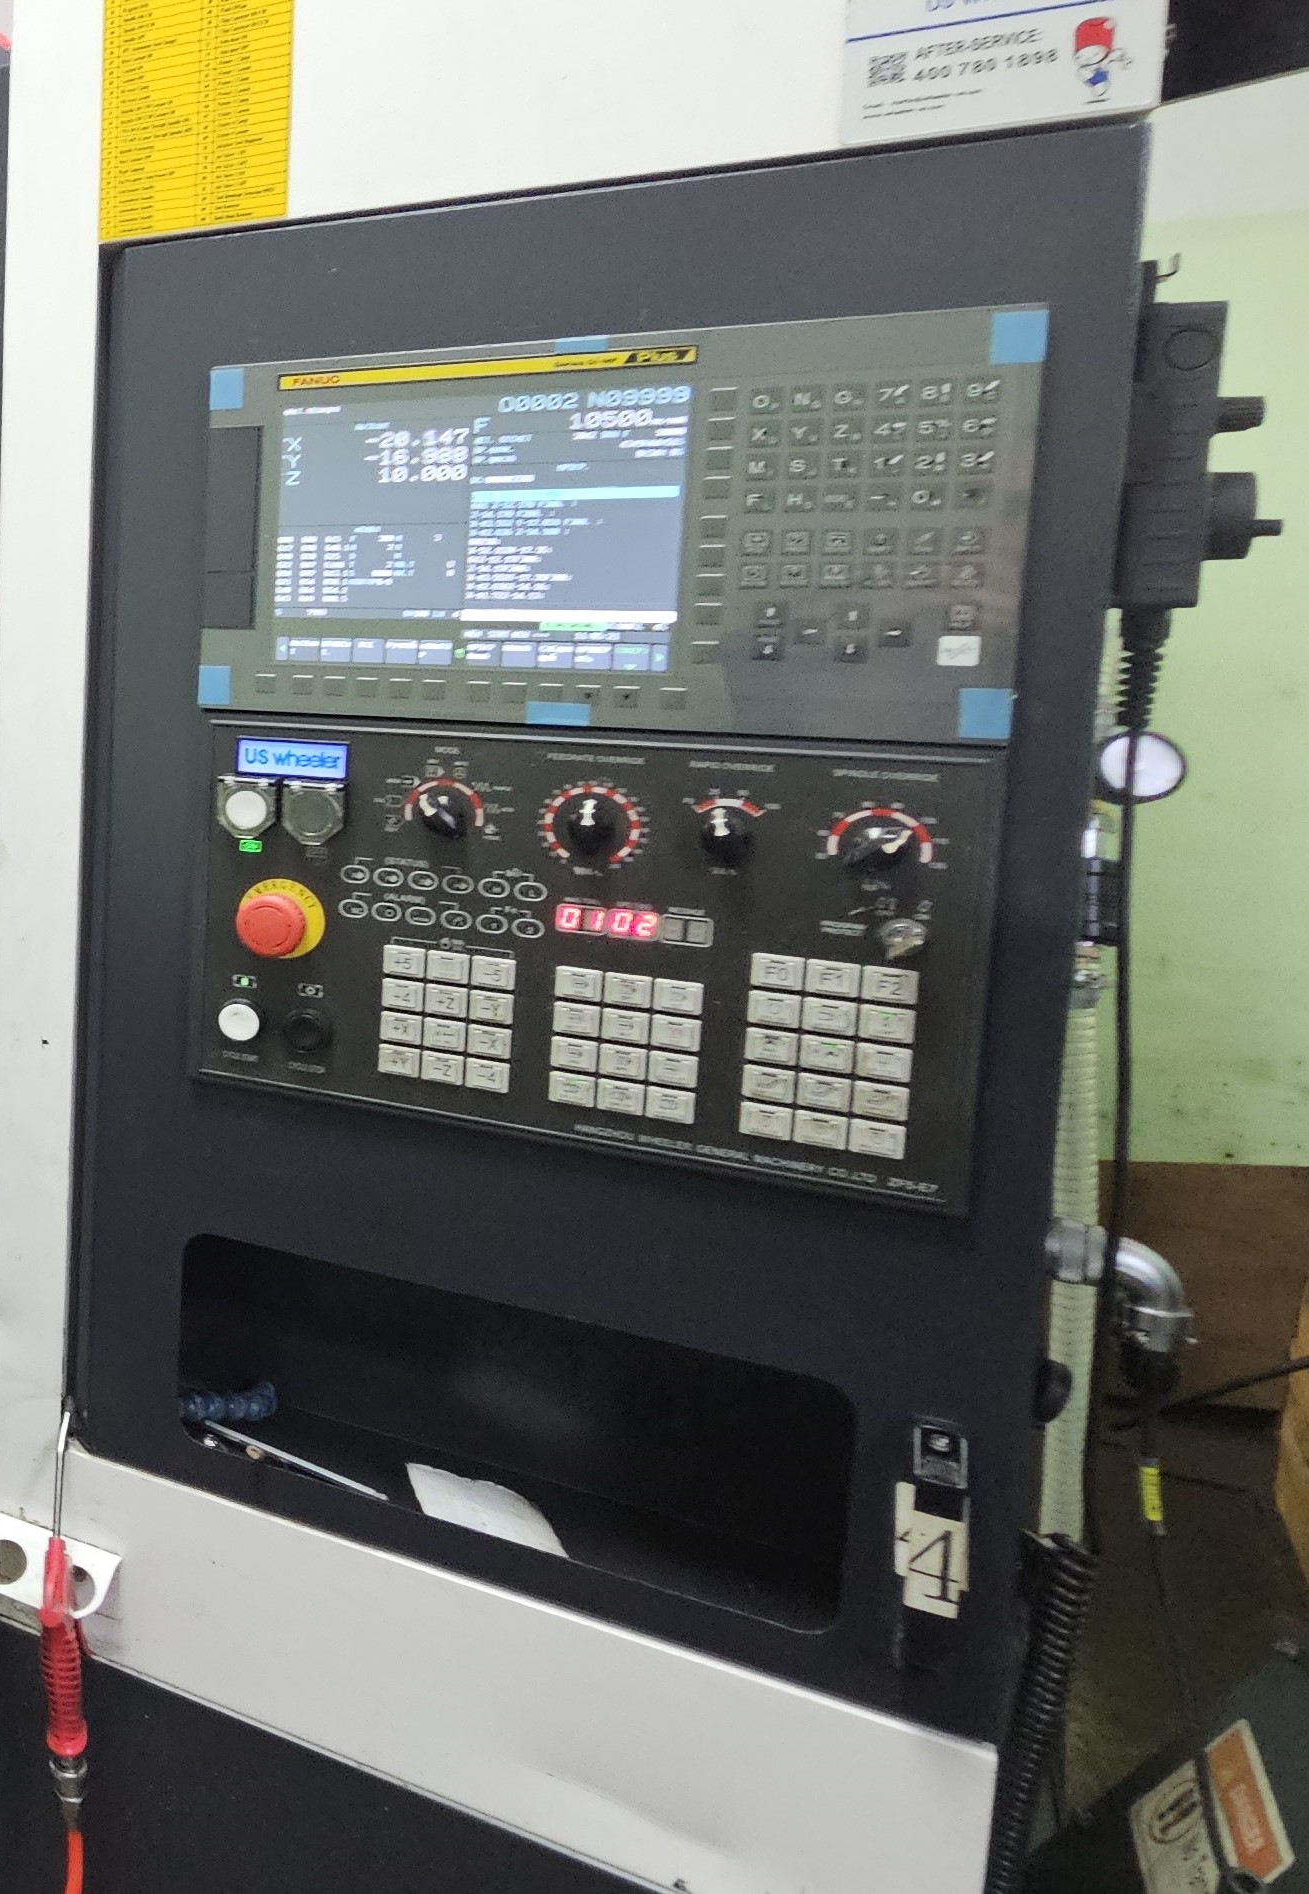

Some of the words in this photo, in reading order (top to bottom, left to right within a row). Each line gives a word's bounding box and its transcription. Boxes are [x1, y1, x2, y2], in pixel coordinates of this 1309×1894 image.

[913, 61, 951, 82] 400
[292, 375, 341, 386] FANUC
[282, 436, 302, 452] X
[282, 453, 301, 469] Y
[283, 470, 302, 486] Z
[378, 463, 468, 484] 10.000
[245, 747, 269, 764] US
[272, 750, 341, 769] wheeler
[876, 979, 902, 996] F2
[908, 1529, 960, 1606] 4
